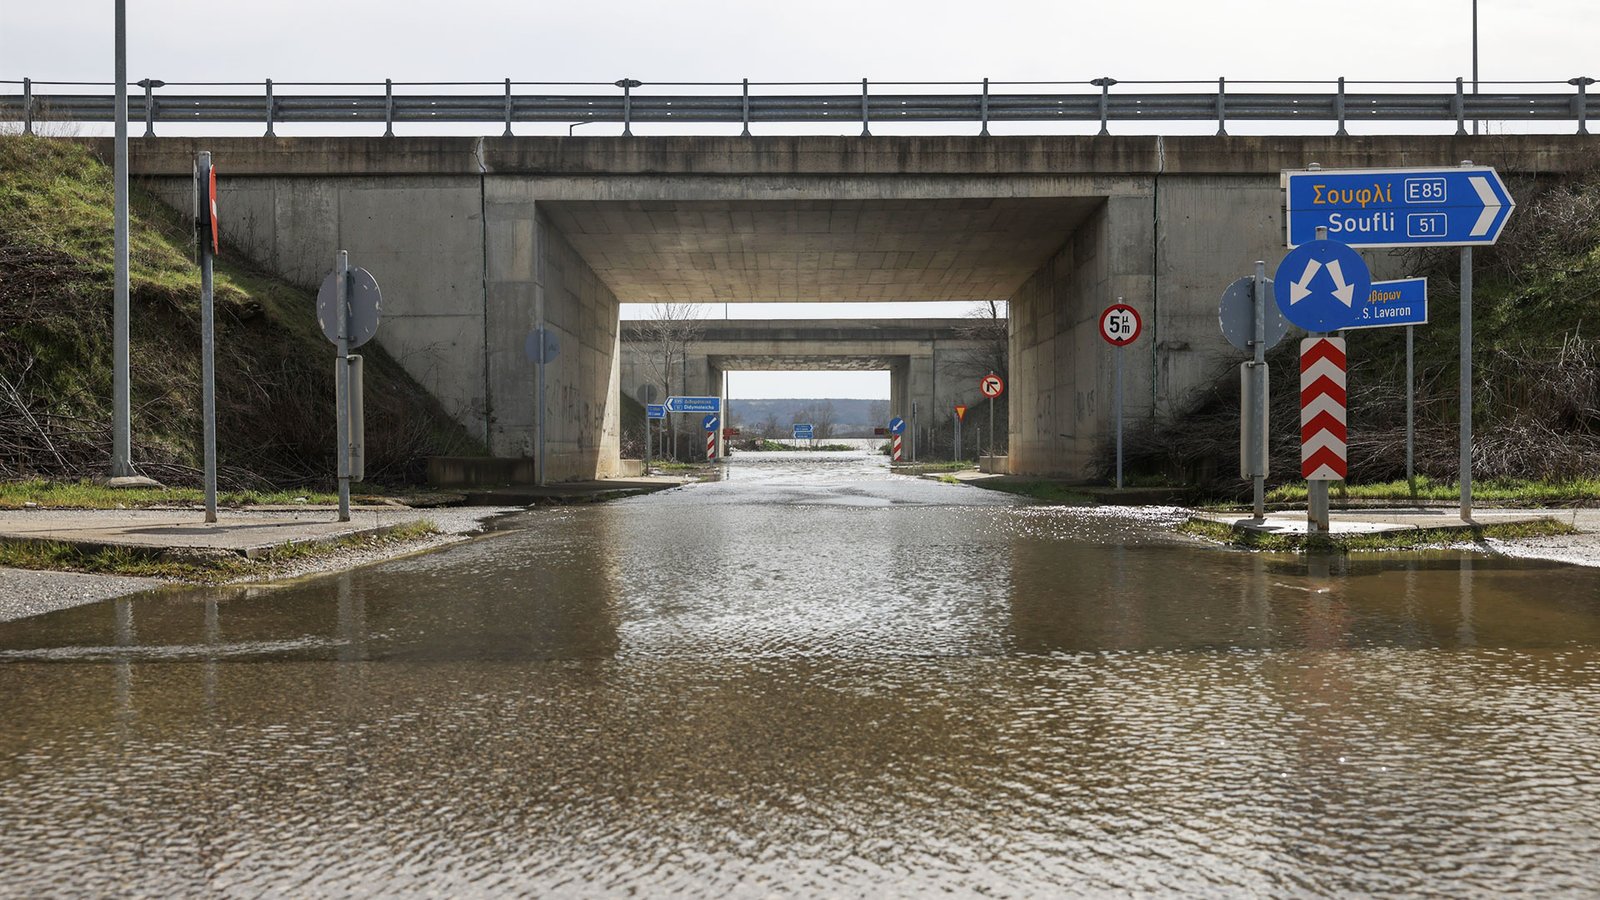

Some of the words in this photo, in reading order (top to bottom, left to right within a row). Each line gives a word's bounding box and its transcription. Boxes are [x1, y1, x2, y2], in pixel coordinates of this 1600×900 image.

[1312, 183, 1393, 208] Σουφλί
[1409, 182, 1442, 199] E85
[1328, 211, 1395, 233] Soufli
[1419, 217, 1436, 233] 51
[1374, 306, 1411, 319] Lavaron
[1109, 316, 1120, 333] 5
